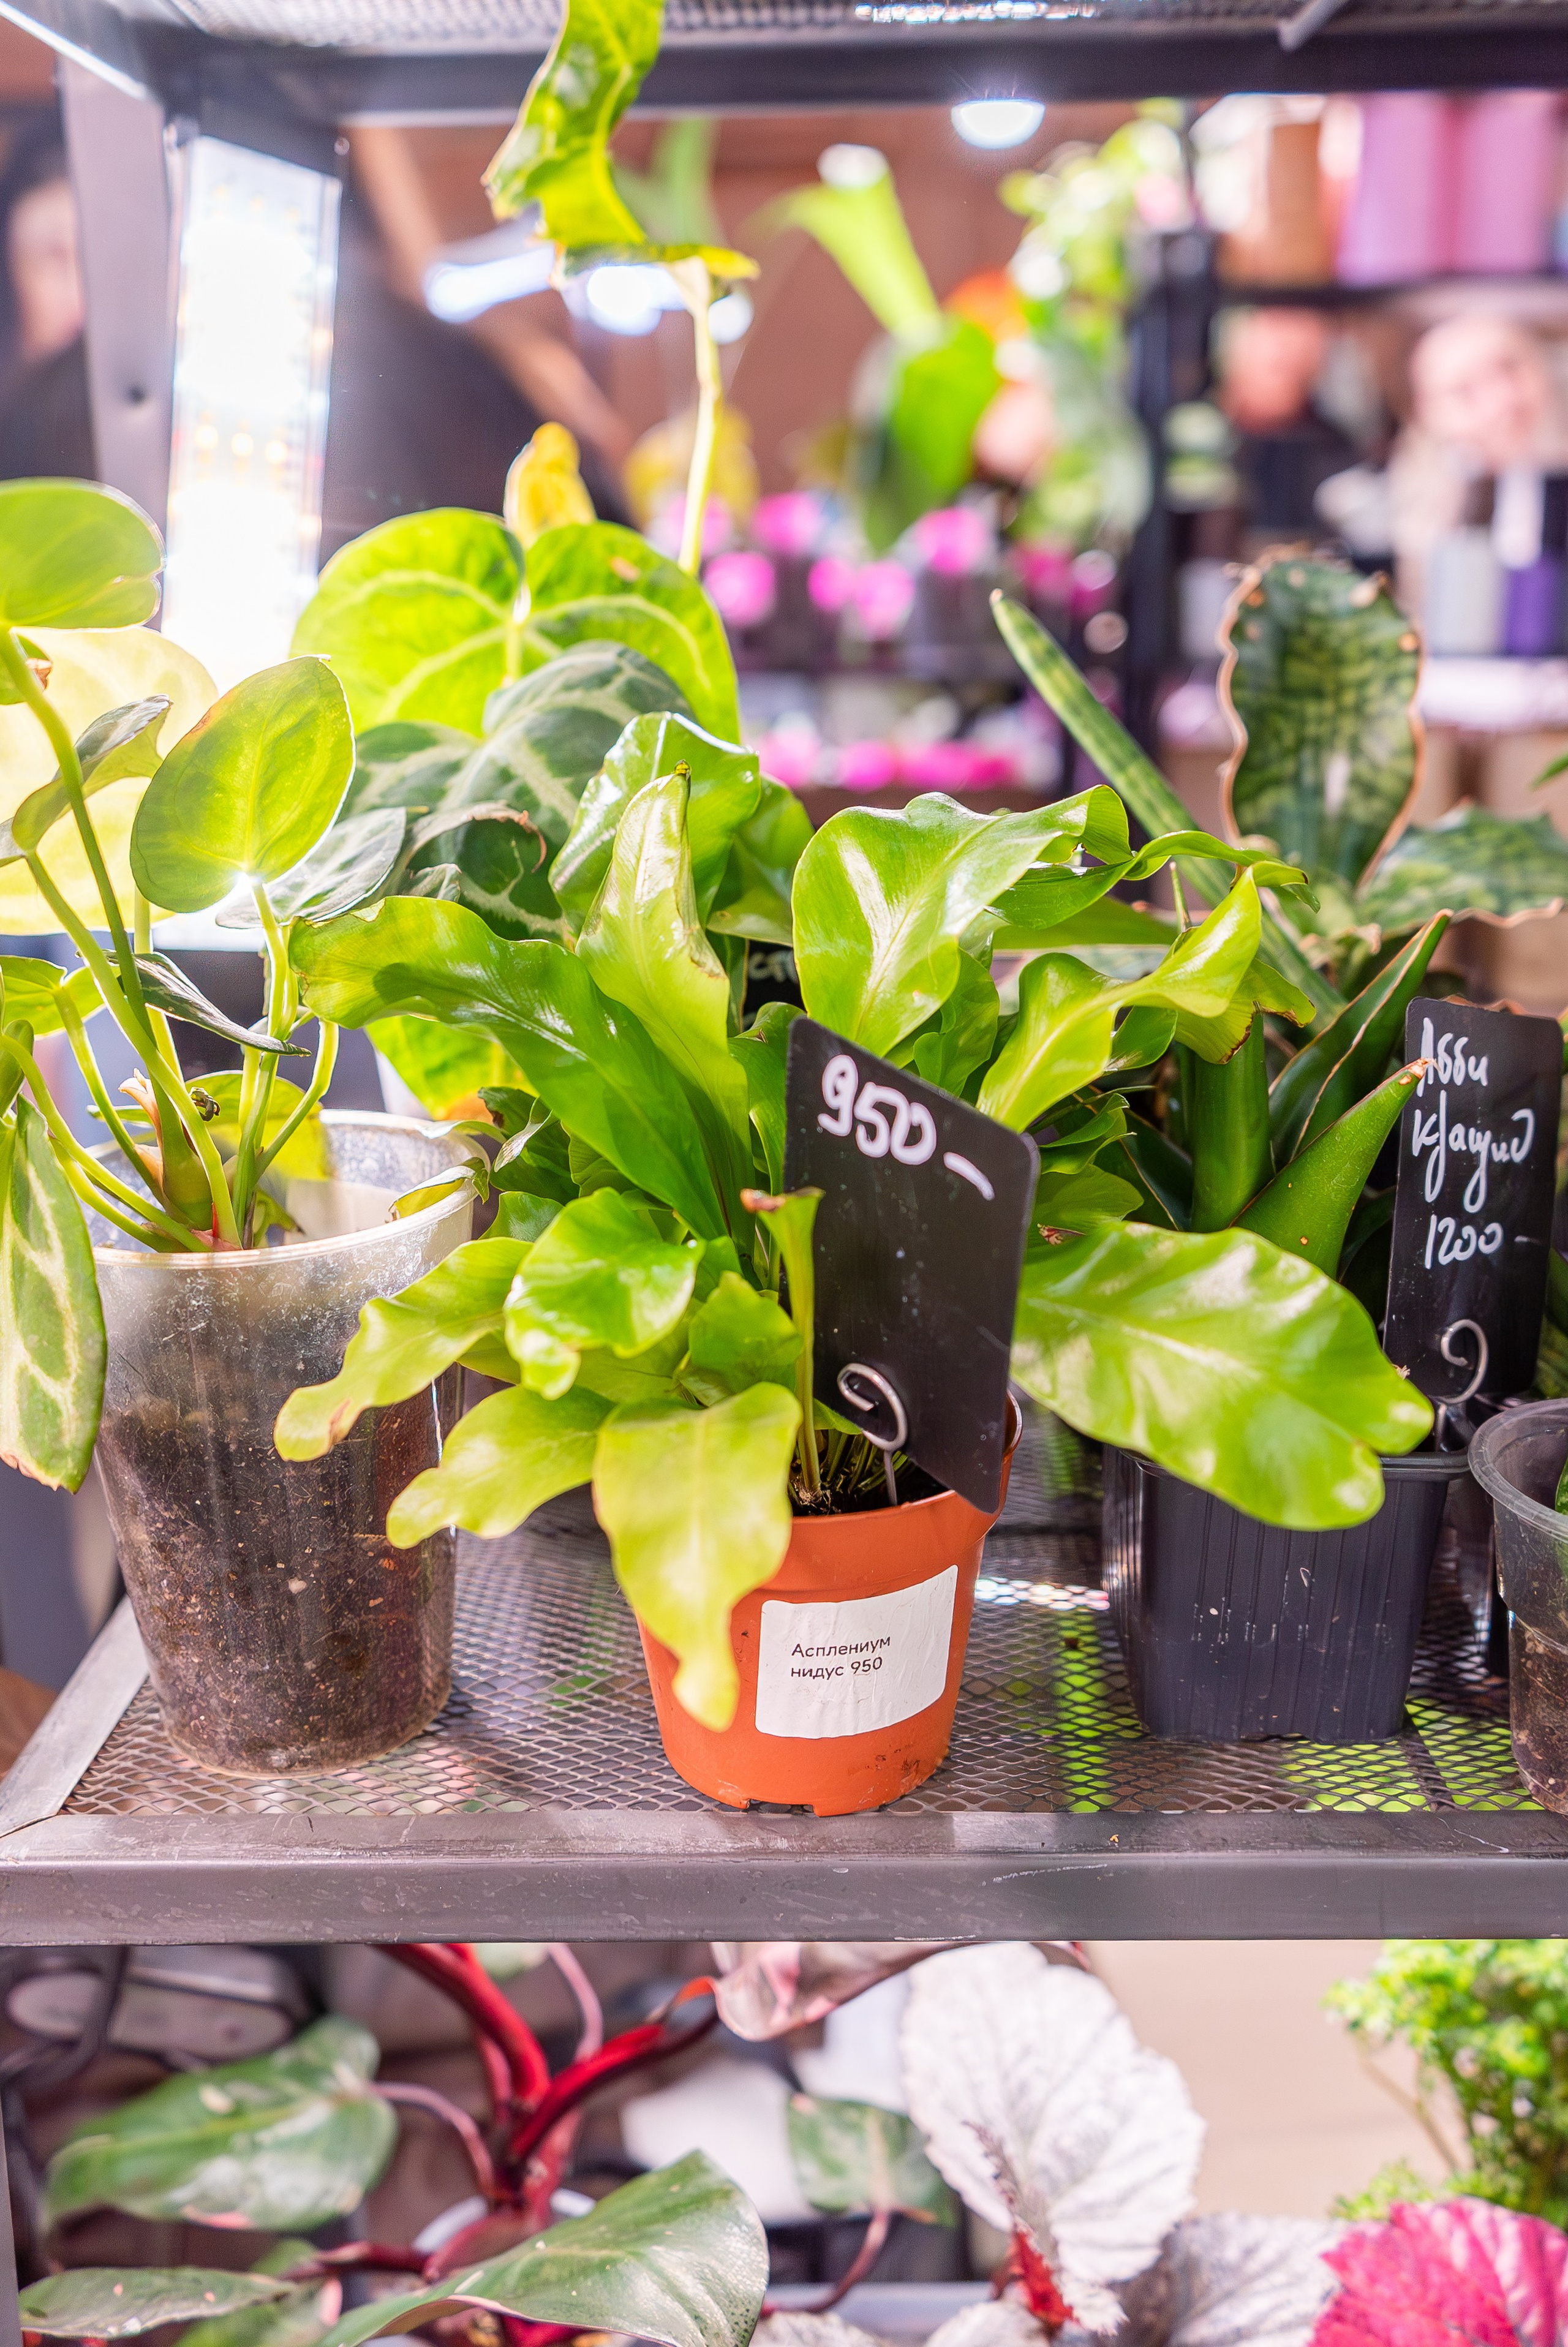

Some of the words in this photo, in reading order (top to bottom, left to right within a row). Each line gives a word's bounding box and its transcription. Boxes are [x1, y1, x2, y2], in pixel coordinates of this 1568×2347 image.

[791, 1636, 891, 1658] Асплениум
[791, 1665, 845, 1680] нидус
[850, 1656, 883, 1675] 950
